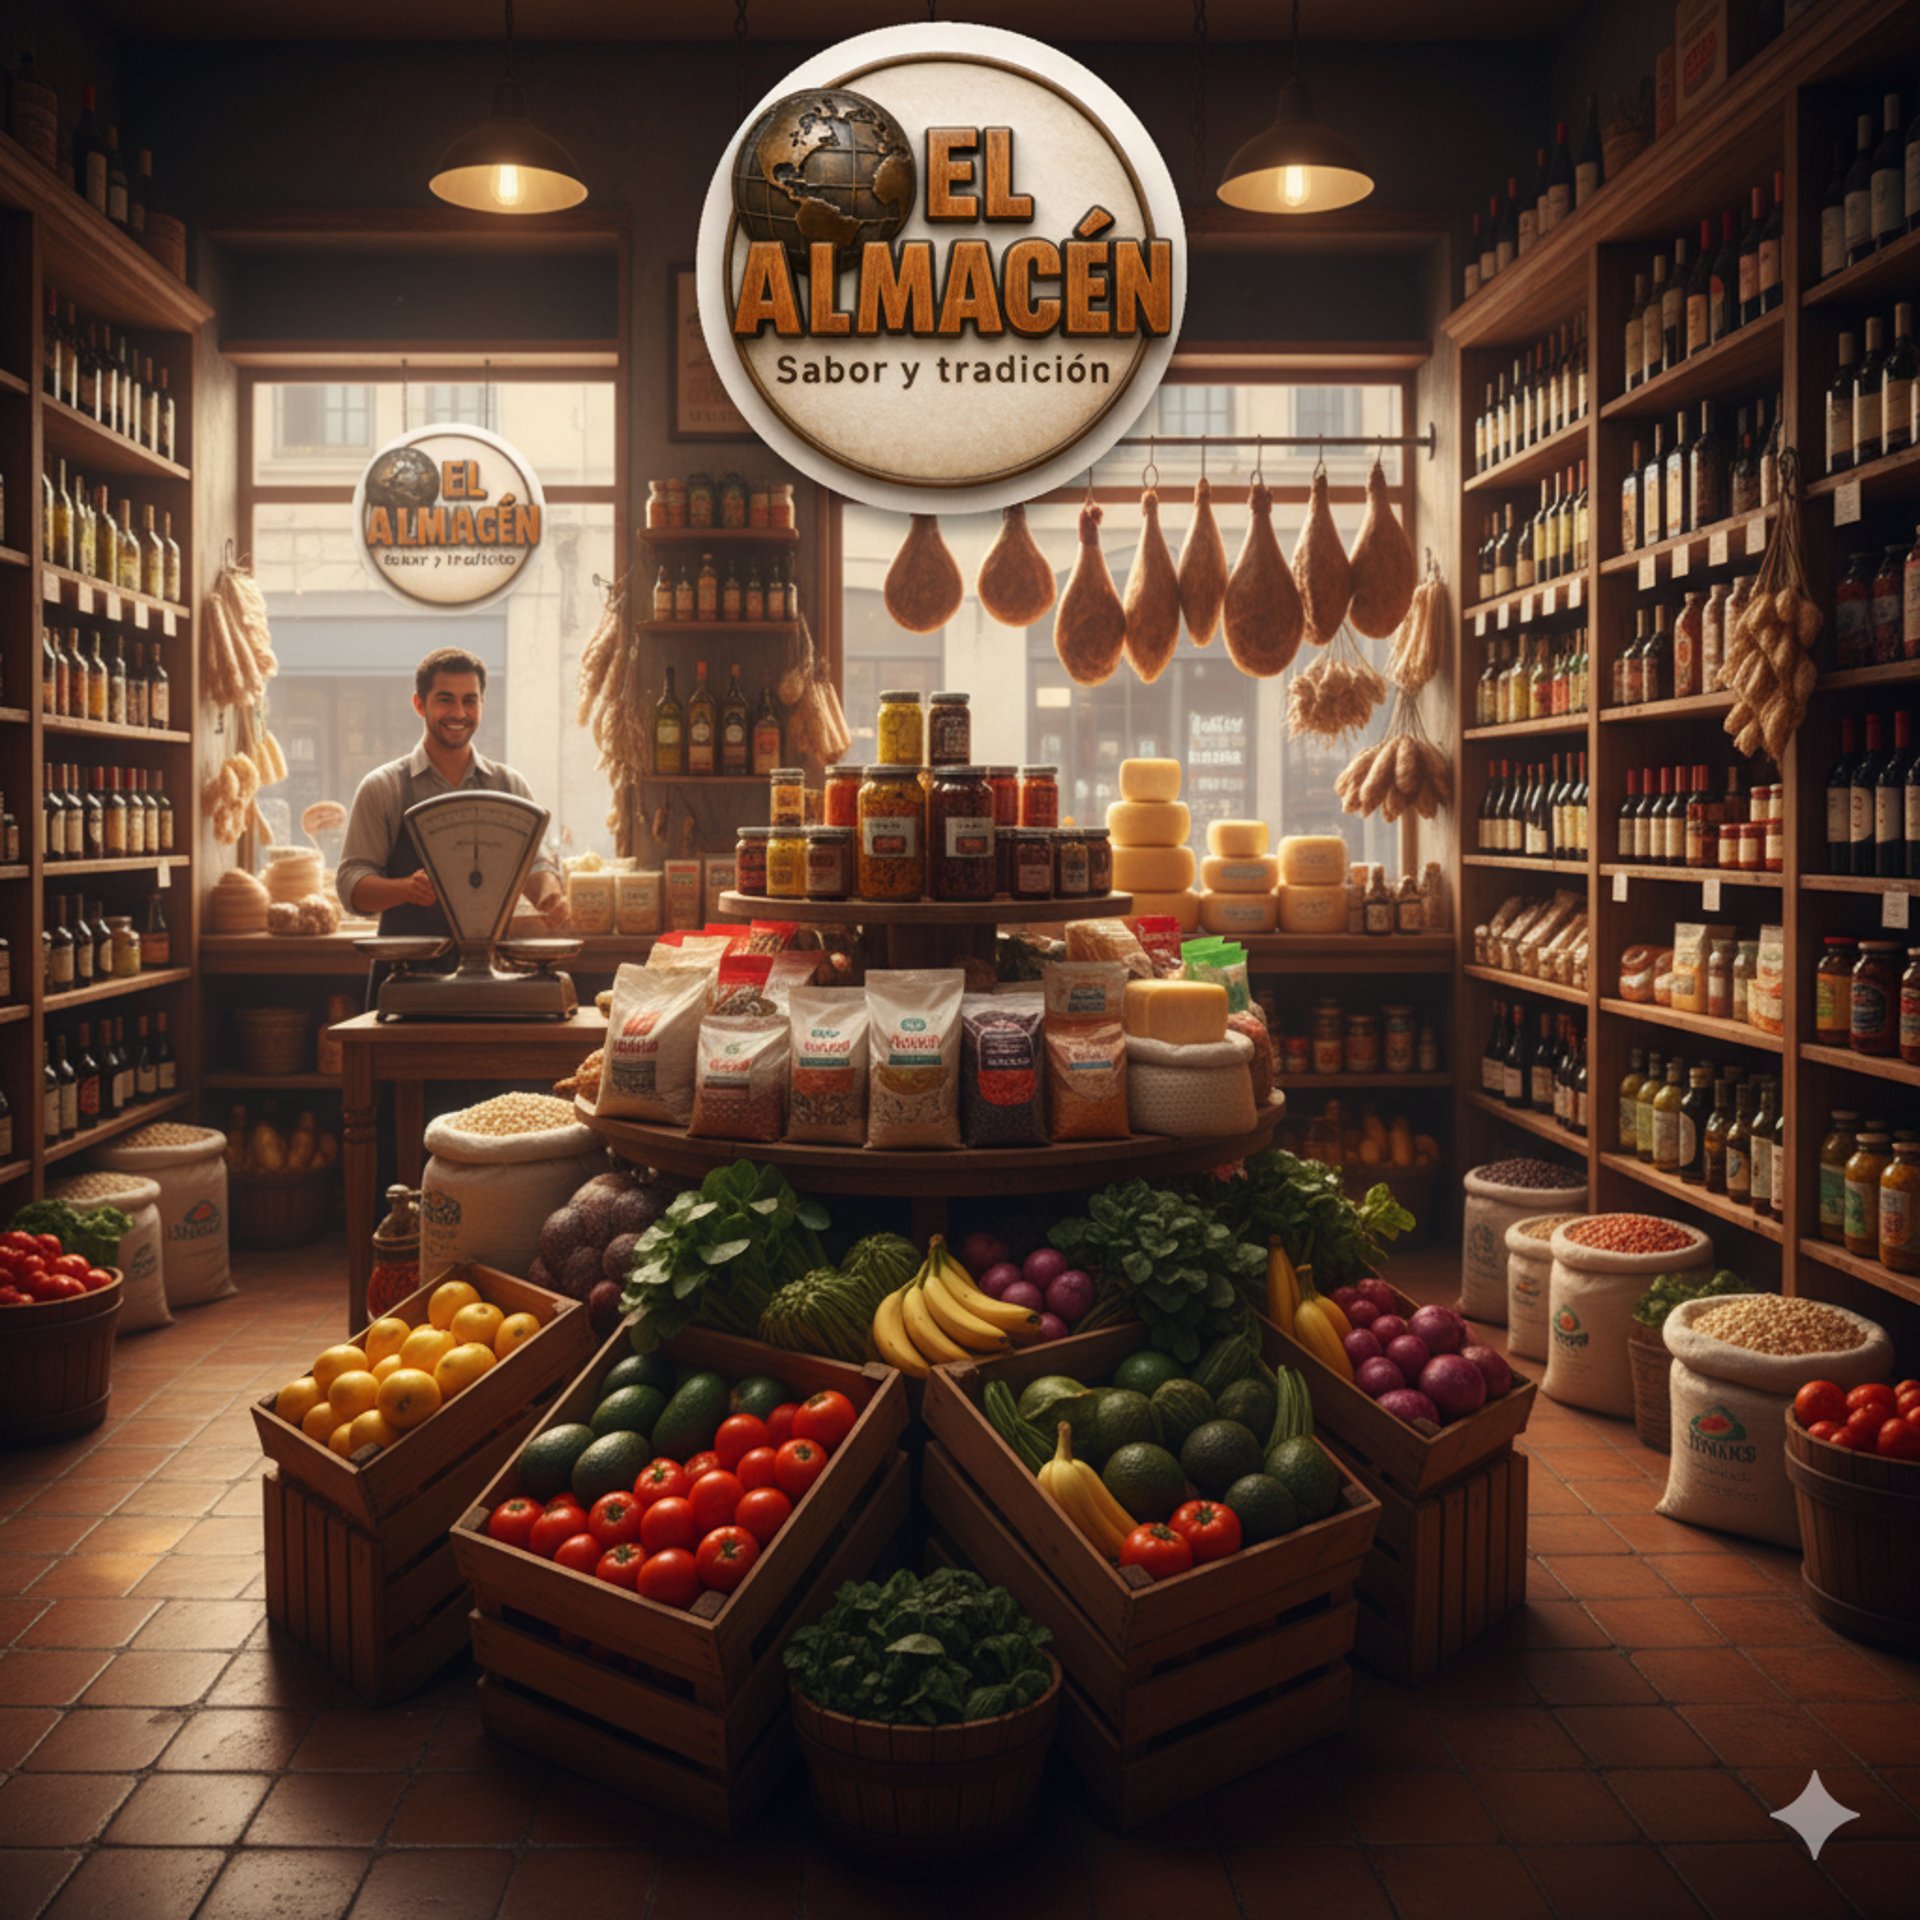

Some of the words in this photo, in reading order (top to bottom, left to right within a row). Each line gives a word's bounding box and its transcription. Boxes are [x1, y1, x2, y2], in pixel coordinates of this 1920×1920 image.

[925, 126, 1034, 224] EL
[733, 205, 1174, 339] ALMACÉN
[776, 355, 888, 385] Sabor
[901, 361, 921, 390] y
[936, 354, 1111, 385] tradición
[442, 460, 488, 501] EL
